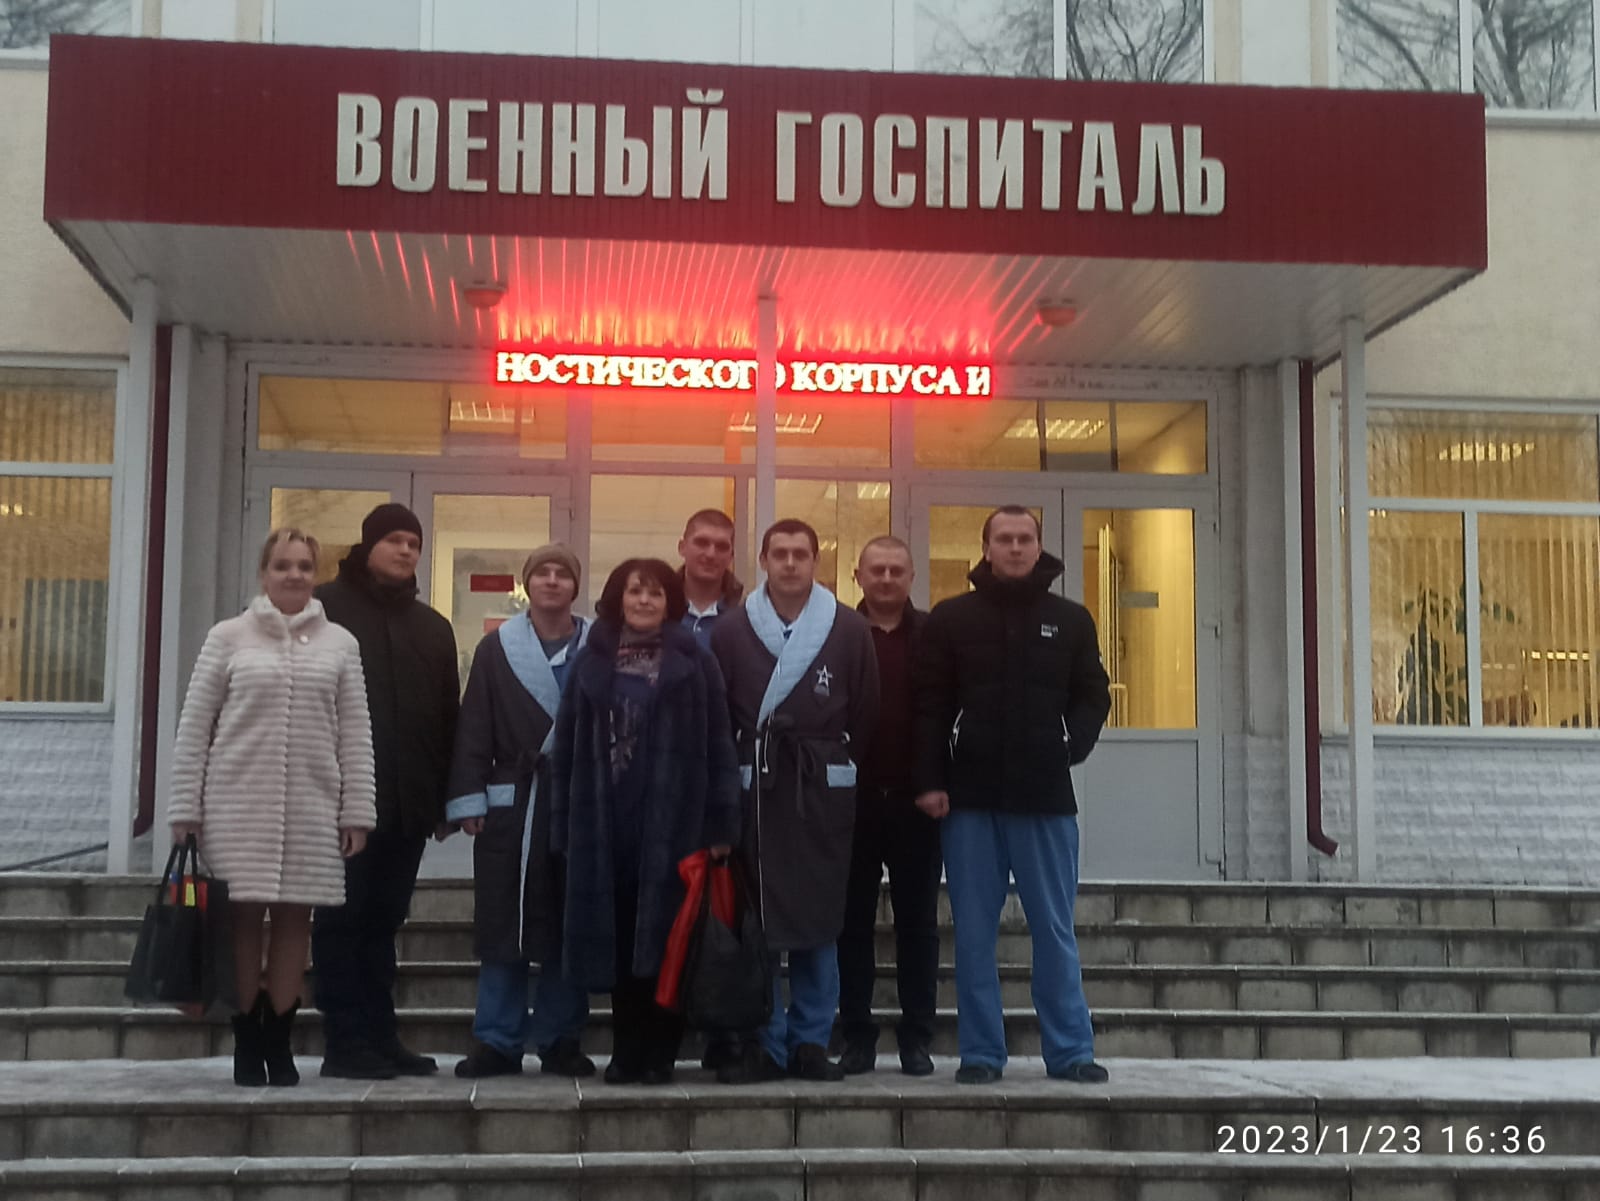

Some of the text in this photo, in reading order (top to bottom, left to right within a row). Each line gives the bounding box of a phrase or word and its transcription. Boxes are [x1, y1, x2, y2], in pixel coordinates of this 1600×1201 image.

[336, 88, 1226, 216] ВОЕННЫЙ ГОСПИТАЛЬ
[791, 361, 962, 394] КОРПУСА
[965, 366, 992, 396] И
